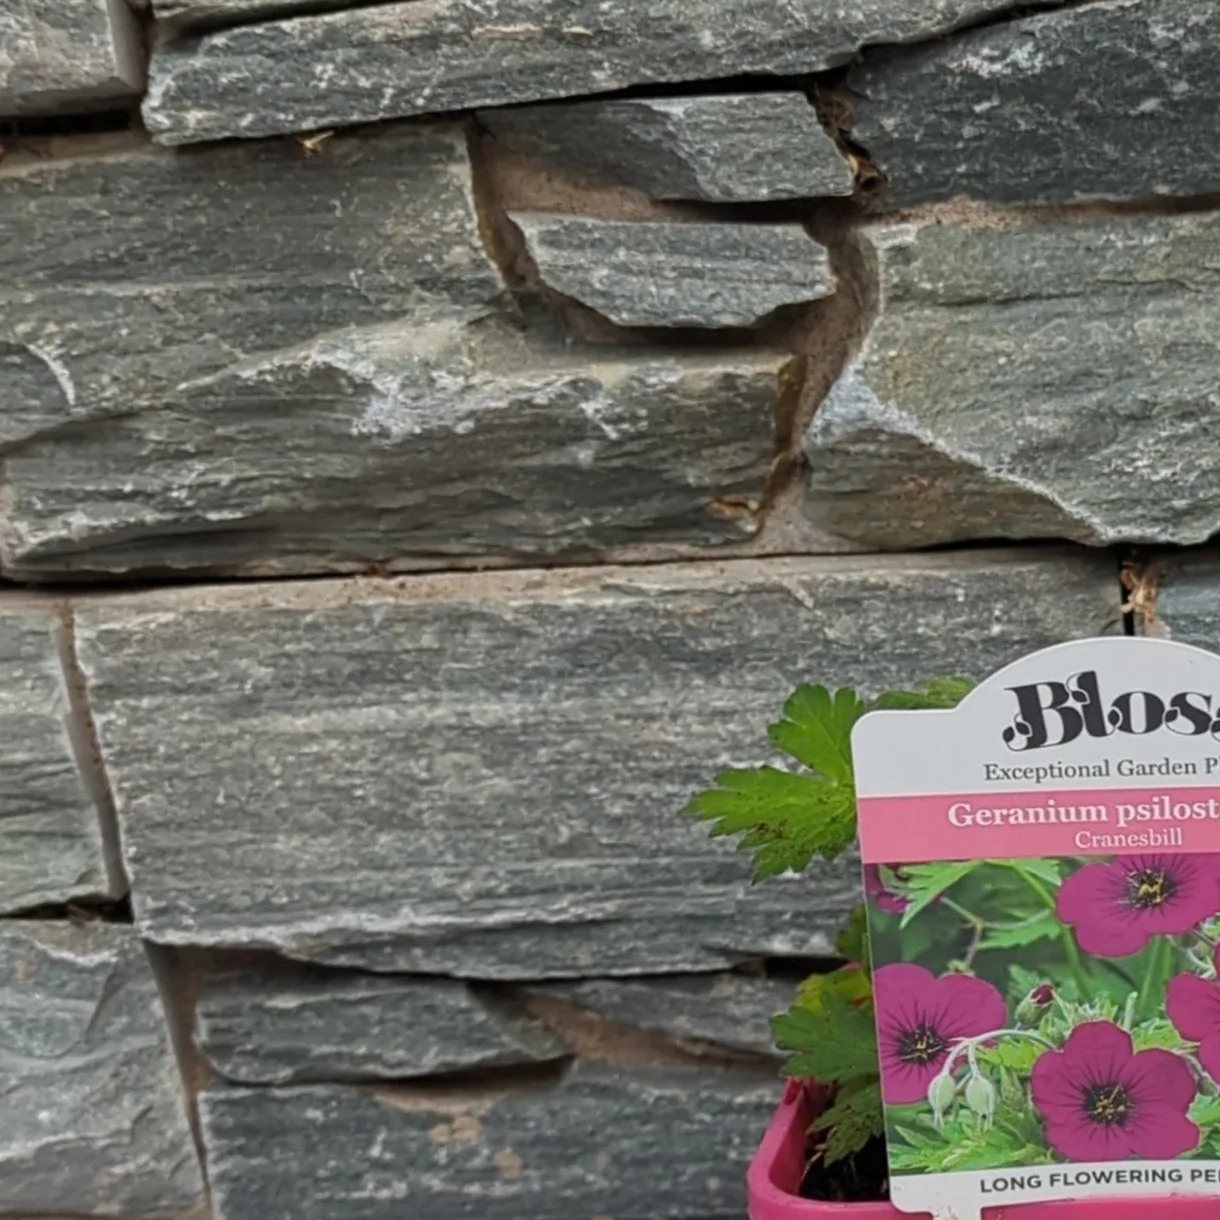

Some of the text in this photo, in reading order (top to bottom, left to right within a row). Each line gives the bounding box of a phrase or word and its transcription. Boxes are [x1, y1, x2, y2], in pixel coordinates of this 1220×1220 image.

[983, 757, 1111, 783] Exceptional
[1117, 757, 1198, 778] Garden
[947, 801, 1110, 828] Geranium
[1075, 828, 1183, 850] Cranesbill
[980, 1175, 1042, 1193] LONG
[1049, 1168, 1183, 1189] FLOWERING
